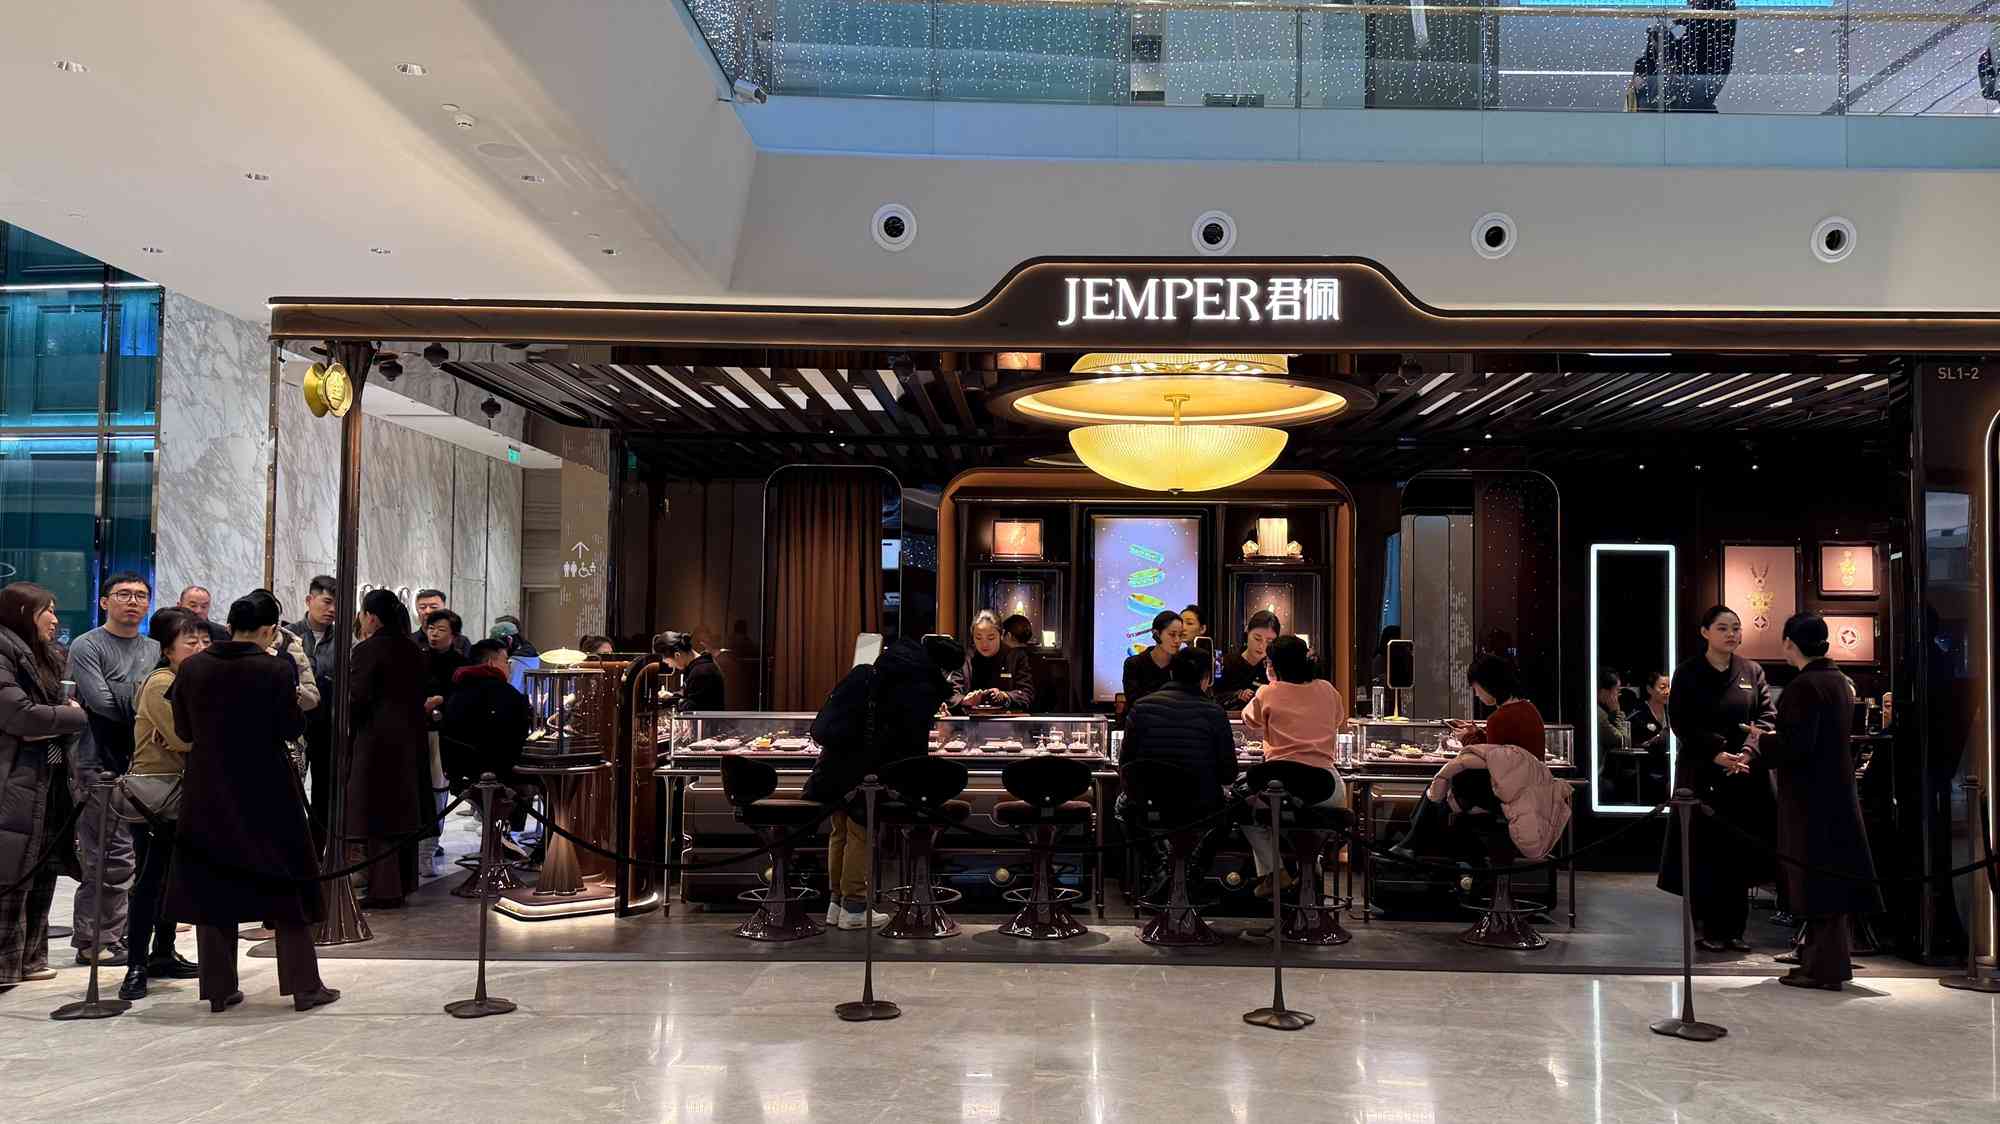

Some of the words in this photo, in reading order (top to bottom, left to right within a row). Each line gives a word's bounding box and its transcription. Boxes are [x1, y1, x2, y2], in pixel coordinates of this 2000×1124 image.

[1057, 277, 1261, 326] JEMPER
[1265, 278, 1340, 321] 君佩
[1937, 367, 1980, 380] SL1-2
